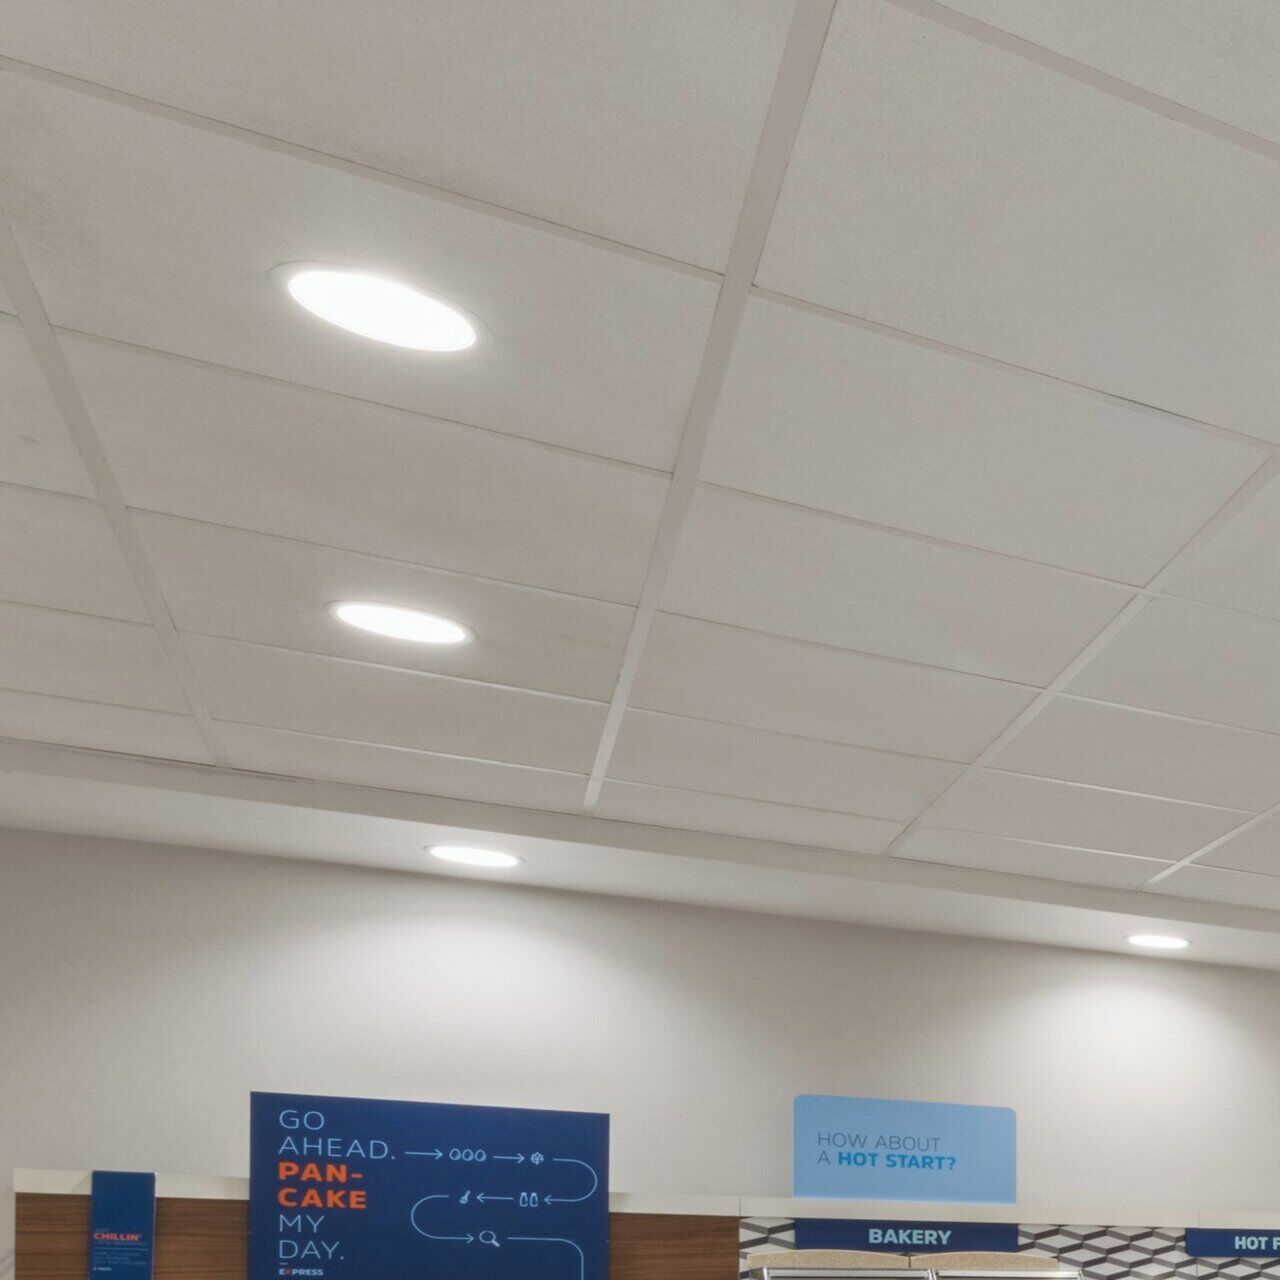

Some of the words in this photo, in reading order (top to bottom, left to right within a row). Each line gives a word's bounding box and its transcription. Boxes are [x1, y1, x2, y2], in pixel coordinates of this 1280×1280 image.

[279, 1109, 325, 1131] GO
[278, 1135, 396, 1160] AHEAD.
[817, 1132, 868, 1148] HOW
[874, 1135, 941, 1152] ABOUT
[816, 1150, 831, 1165] A
[838, 1151, 879, 1167] HOT
[885, 1153, 957, 1170] START?
[278, 1161, 364, 1183] PAN-
[277, 1187, 367, 1209] CAKE
[279, 1213, 325, 1234] MY
[868, 1228, 952, 1245] BAKERY
[1234, 1236, 1268, 1250] HOT
[279, 1239, 345, 1260] DAY.
[279, 1268, 324, 1276] EXPRESS
